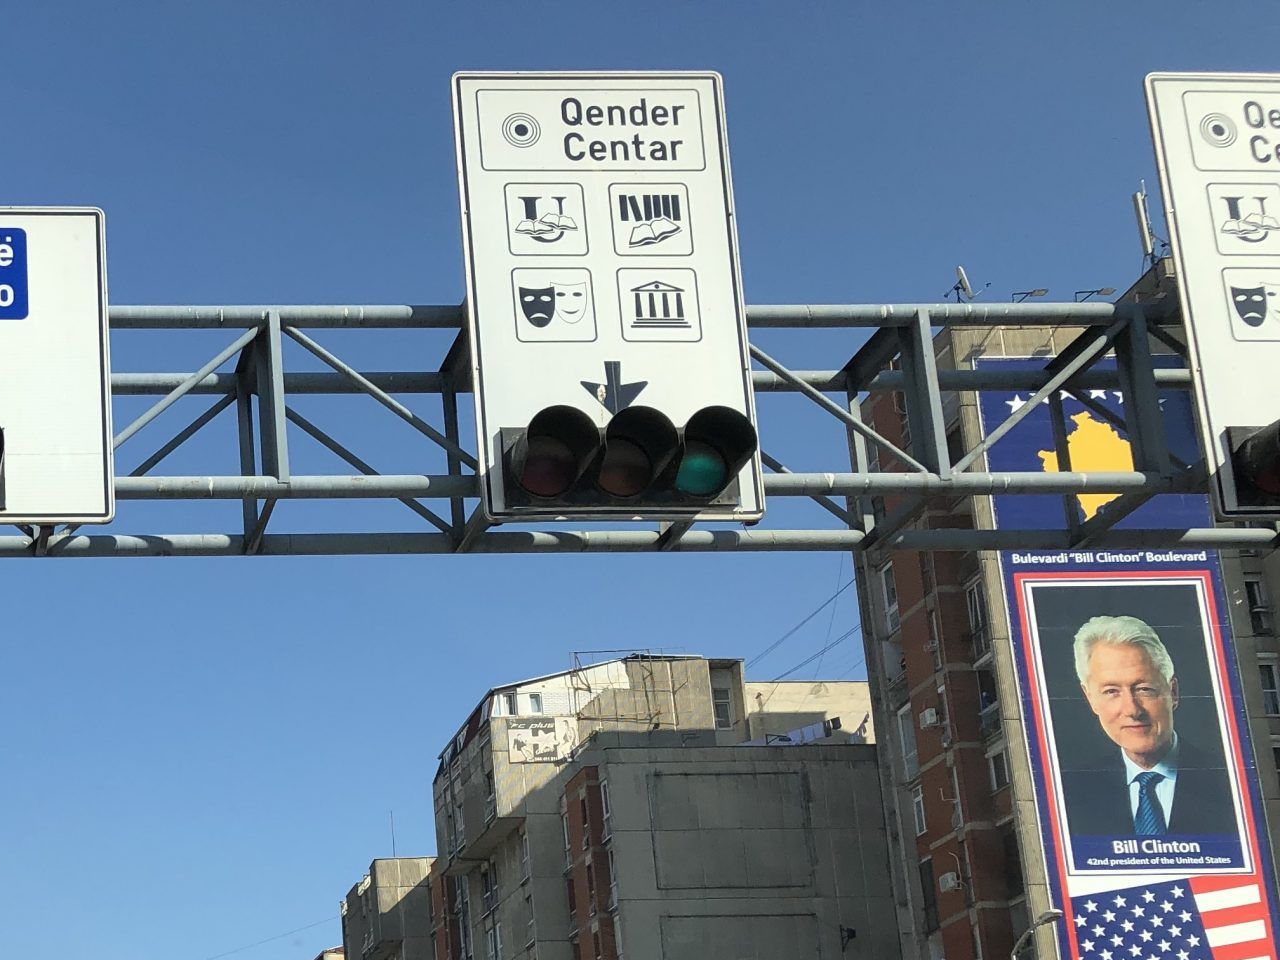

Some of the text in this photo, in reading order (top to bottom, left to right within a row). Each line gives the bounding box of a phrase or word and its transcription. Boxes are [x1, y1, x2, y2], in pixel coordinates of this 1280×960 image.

[560, 97, 685, 126] Qender
[563, 132, 683, 161] Centar
[1012, 553, 1068, 564] Bulevardi
[1146, 551, 1207, 562] Boulevard
[1112, 839, 1200, 854] Bill Clinton
[1087, 856, 1231, 866] 42nd president of the United States
